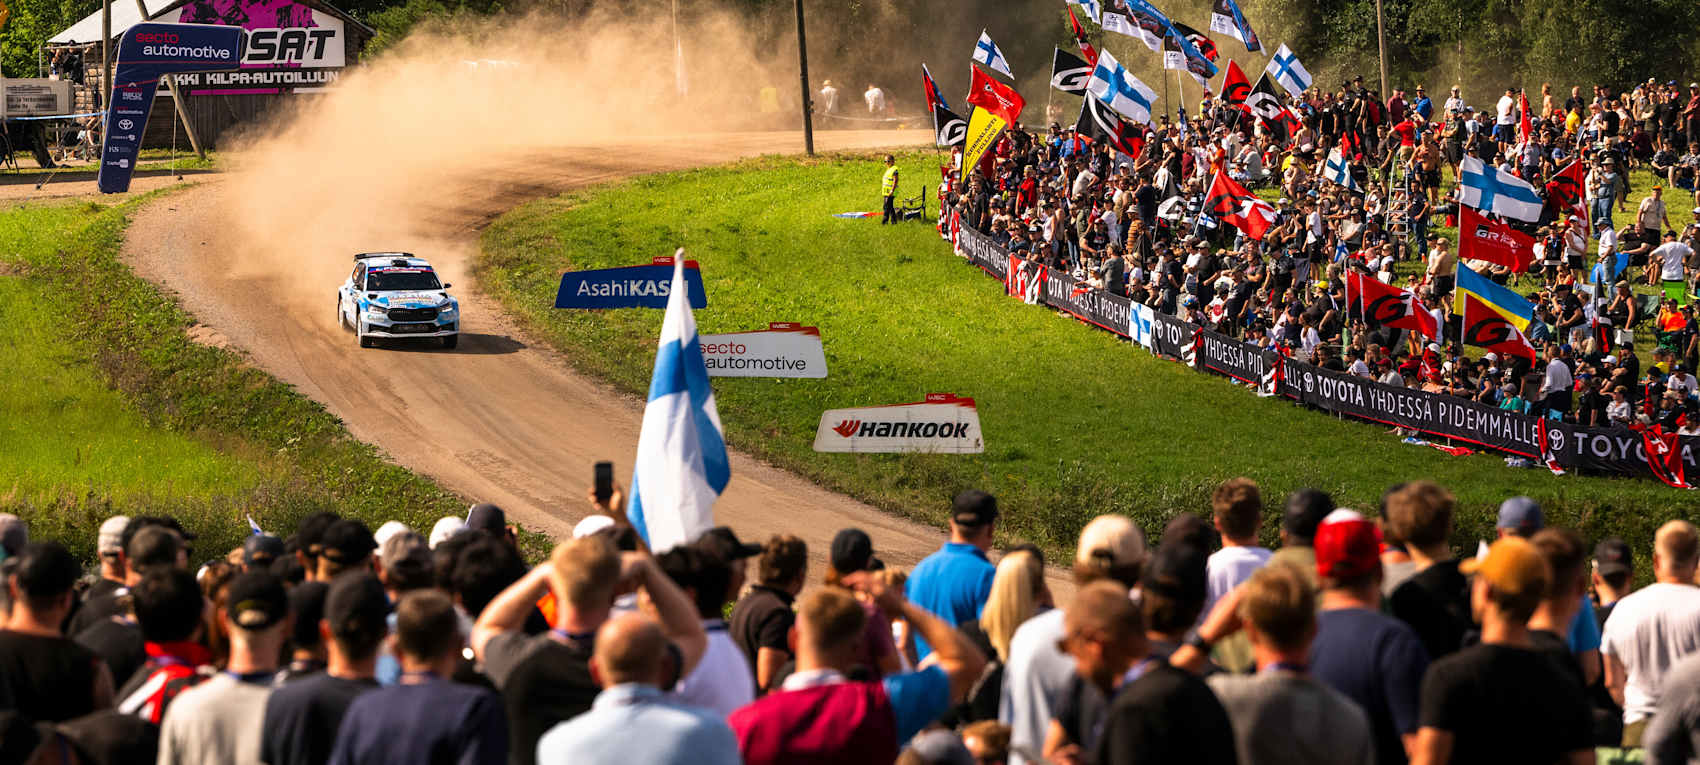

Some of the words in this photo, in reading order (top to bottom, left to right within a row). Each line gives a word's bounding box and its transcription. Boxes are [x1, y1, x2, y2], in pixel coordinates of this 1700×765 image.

[135, 32, 180, 44] secto
[241, 30, 336, 61] SAT
[143, 44, 230, 59] automotive
[160, 74, 200, 86] AKKI
[576, 279, 689, 297] AsahiKASI
[699, 341, 746, 354] secto
[705, 356, 806, 371] automotive
[1204, 335, 1246, 370] YHDESSÄ
[1317, 374, 1365, 407] TOYOTA
[1368, 386, 1433, 422] YHDESSÄ
[1439, 401, 1539, 447] PIDEMMÄLLE
[1573, 432, 1697, 466] TOYA
